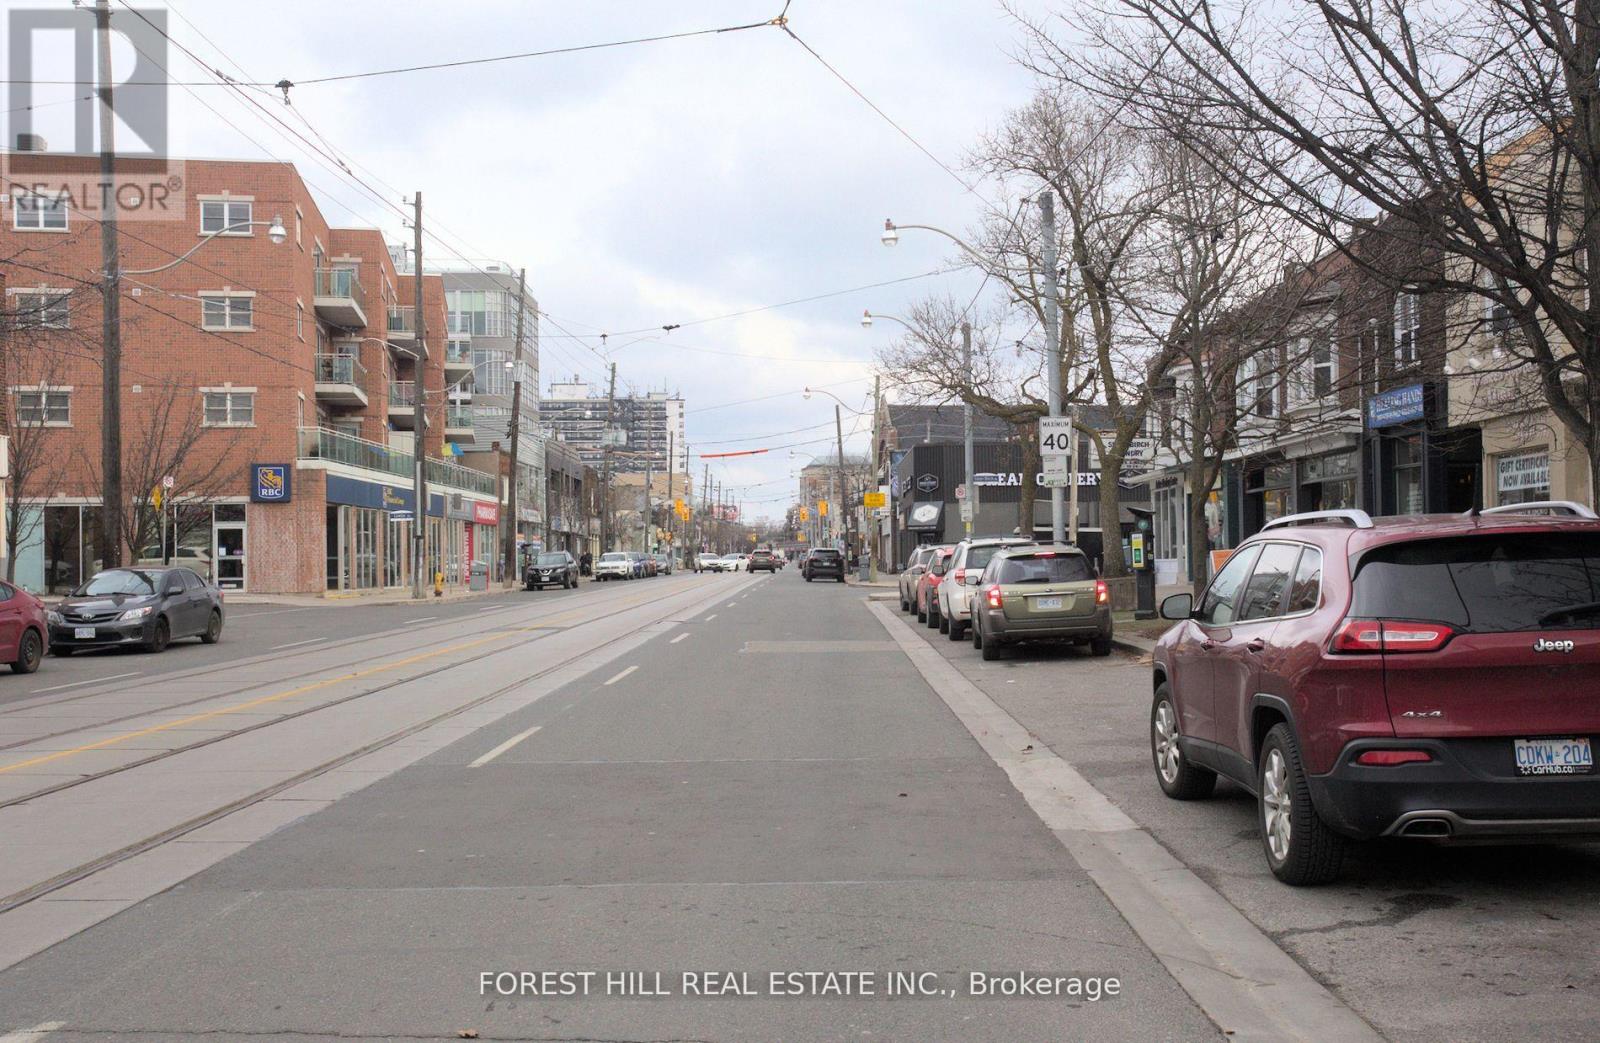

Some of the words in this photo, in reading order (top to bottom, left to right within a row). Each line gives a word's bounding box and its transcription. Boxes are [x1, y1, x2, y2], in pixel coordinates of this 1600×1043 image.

[1043, 433, 1069, 450] 40
[1500, 460, 1514, 474] GIFT
[1503, 474, 1519, 488] NOW
[261, 488, 281, 496] RBC
[1534, 638, 1575, 653] Jeep
[1401, 710, 1443, 719] 4x4
